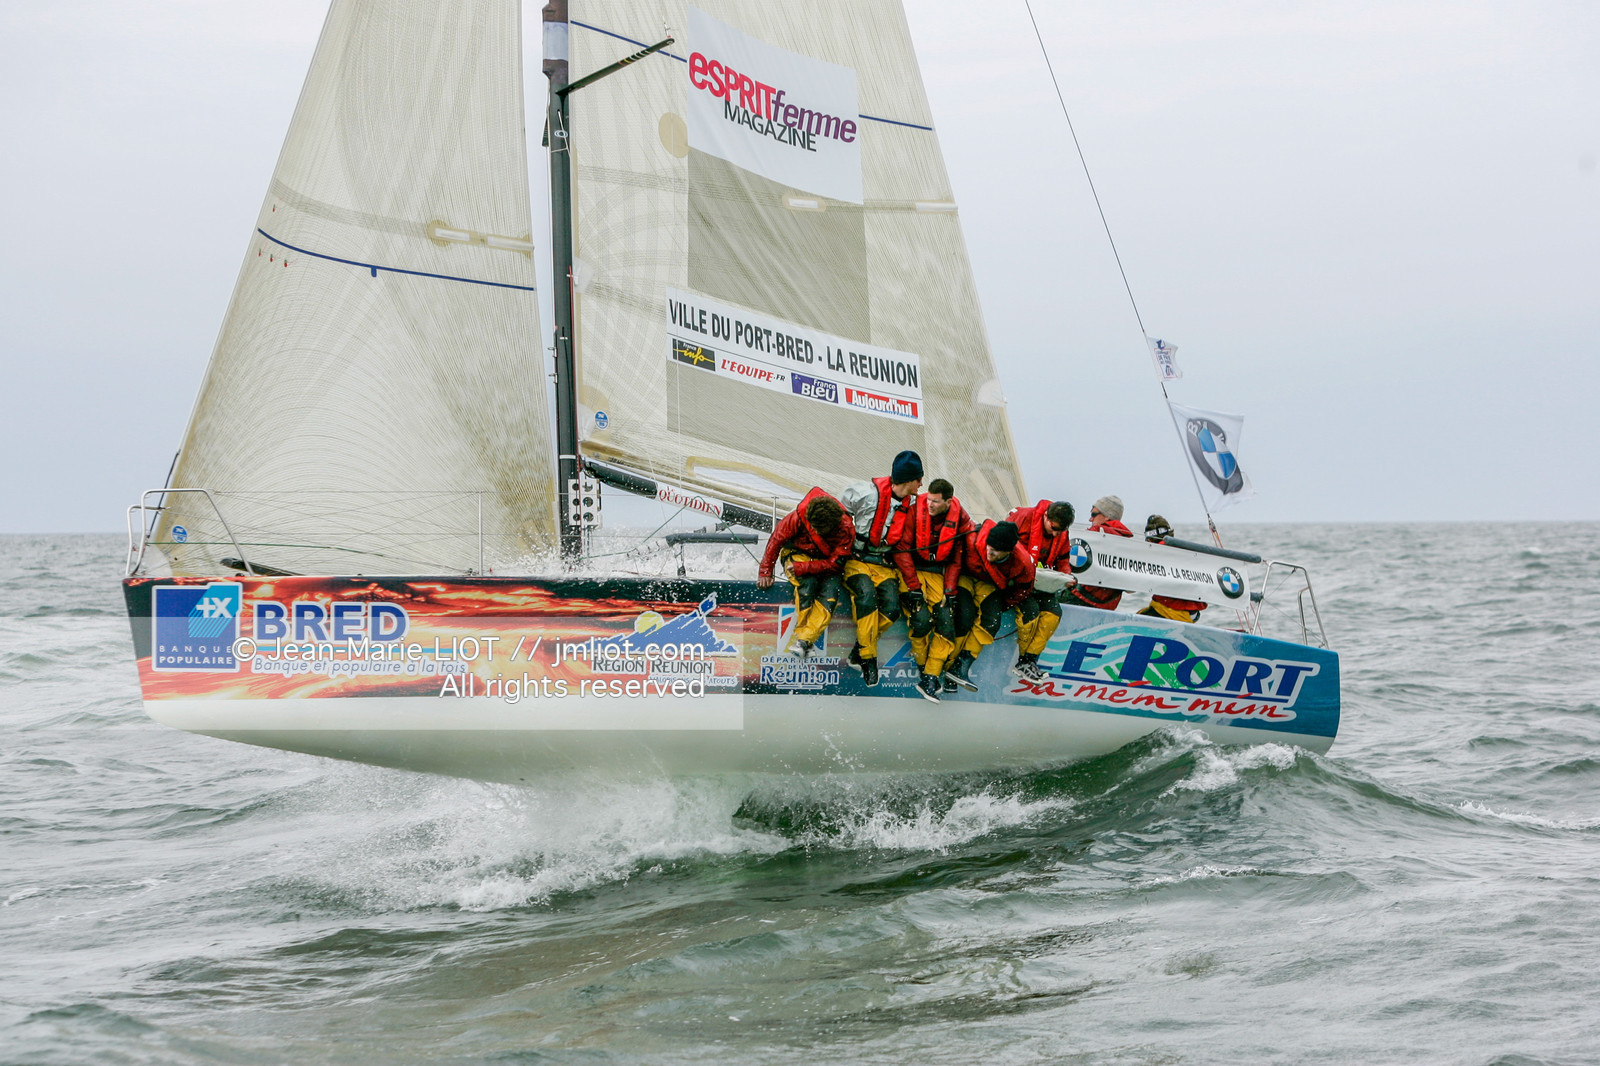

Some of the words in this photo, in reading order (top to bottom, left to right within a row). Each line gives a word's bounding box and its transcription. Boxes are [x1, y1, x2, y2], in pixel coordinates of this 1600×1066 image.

[724, 100, 817, 152] MAGAZINE
[669, 299, 707, 336] VILLE
[711, 313, 731, 341] DU
[826, 346, 846, 373] LA
[849, 352, 919, 388] REUNION
[682, 342, 697, 351] France
[813, 379, 836, 390] France
[1097, 553, 1117, 569] VILLE
[1118, 557, 1128, 571] DU
[1171, 567, 1181, 579] LA
[1182, 569, 1214, 584] REUNION
[256, 603, 407, 641] BRED
[159, 645, 232, 654] BANQUE
[159, 656, 233, 665] POPULAIRE
[254, 657, 308, 674] Banque
[314, 660, 328, 671] et
[332, 660, 401, 675] populaire
[422, 660, 434, 673] la
[1118, 635, 1312, 697] PORT
[761, 665, 838, 683] Réunion
